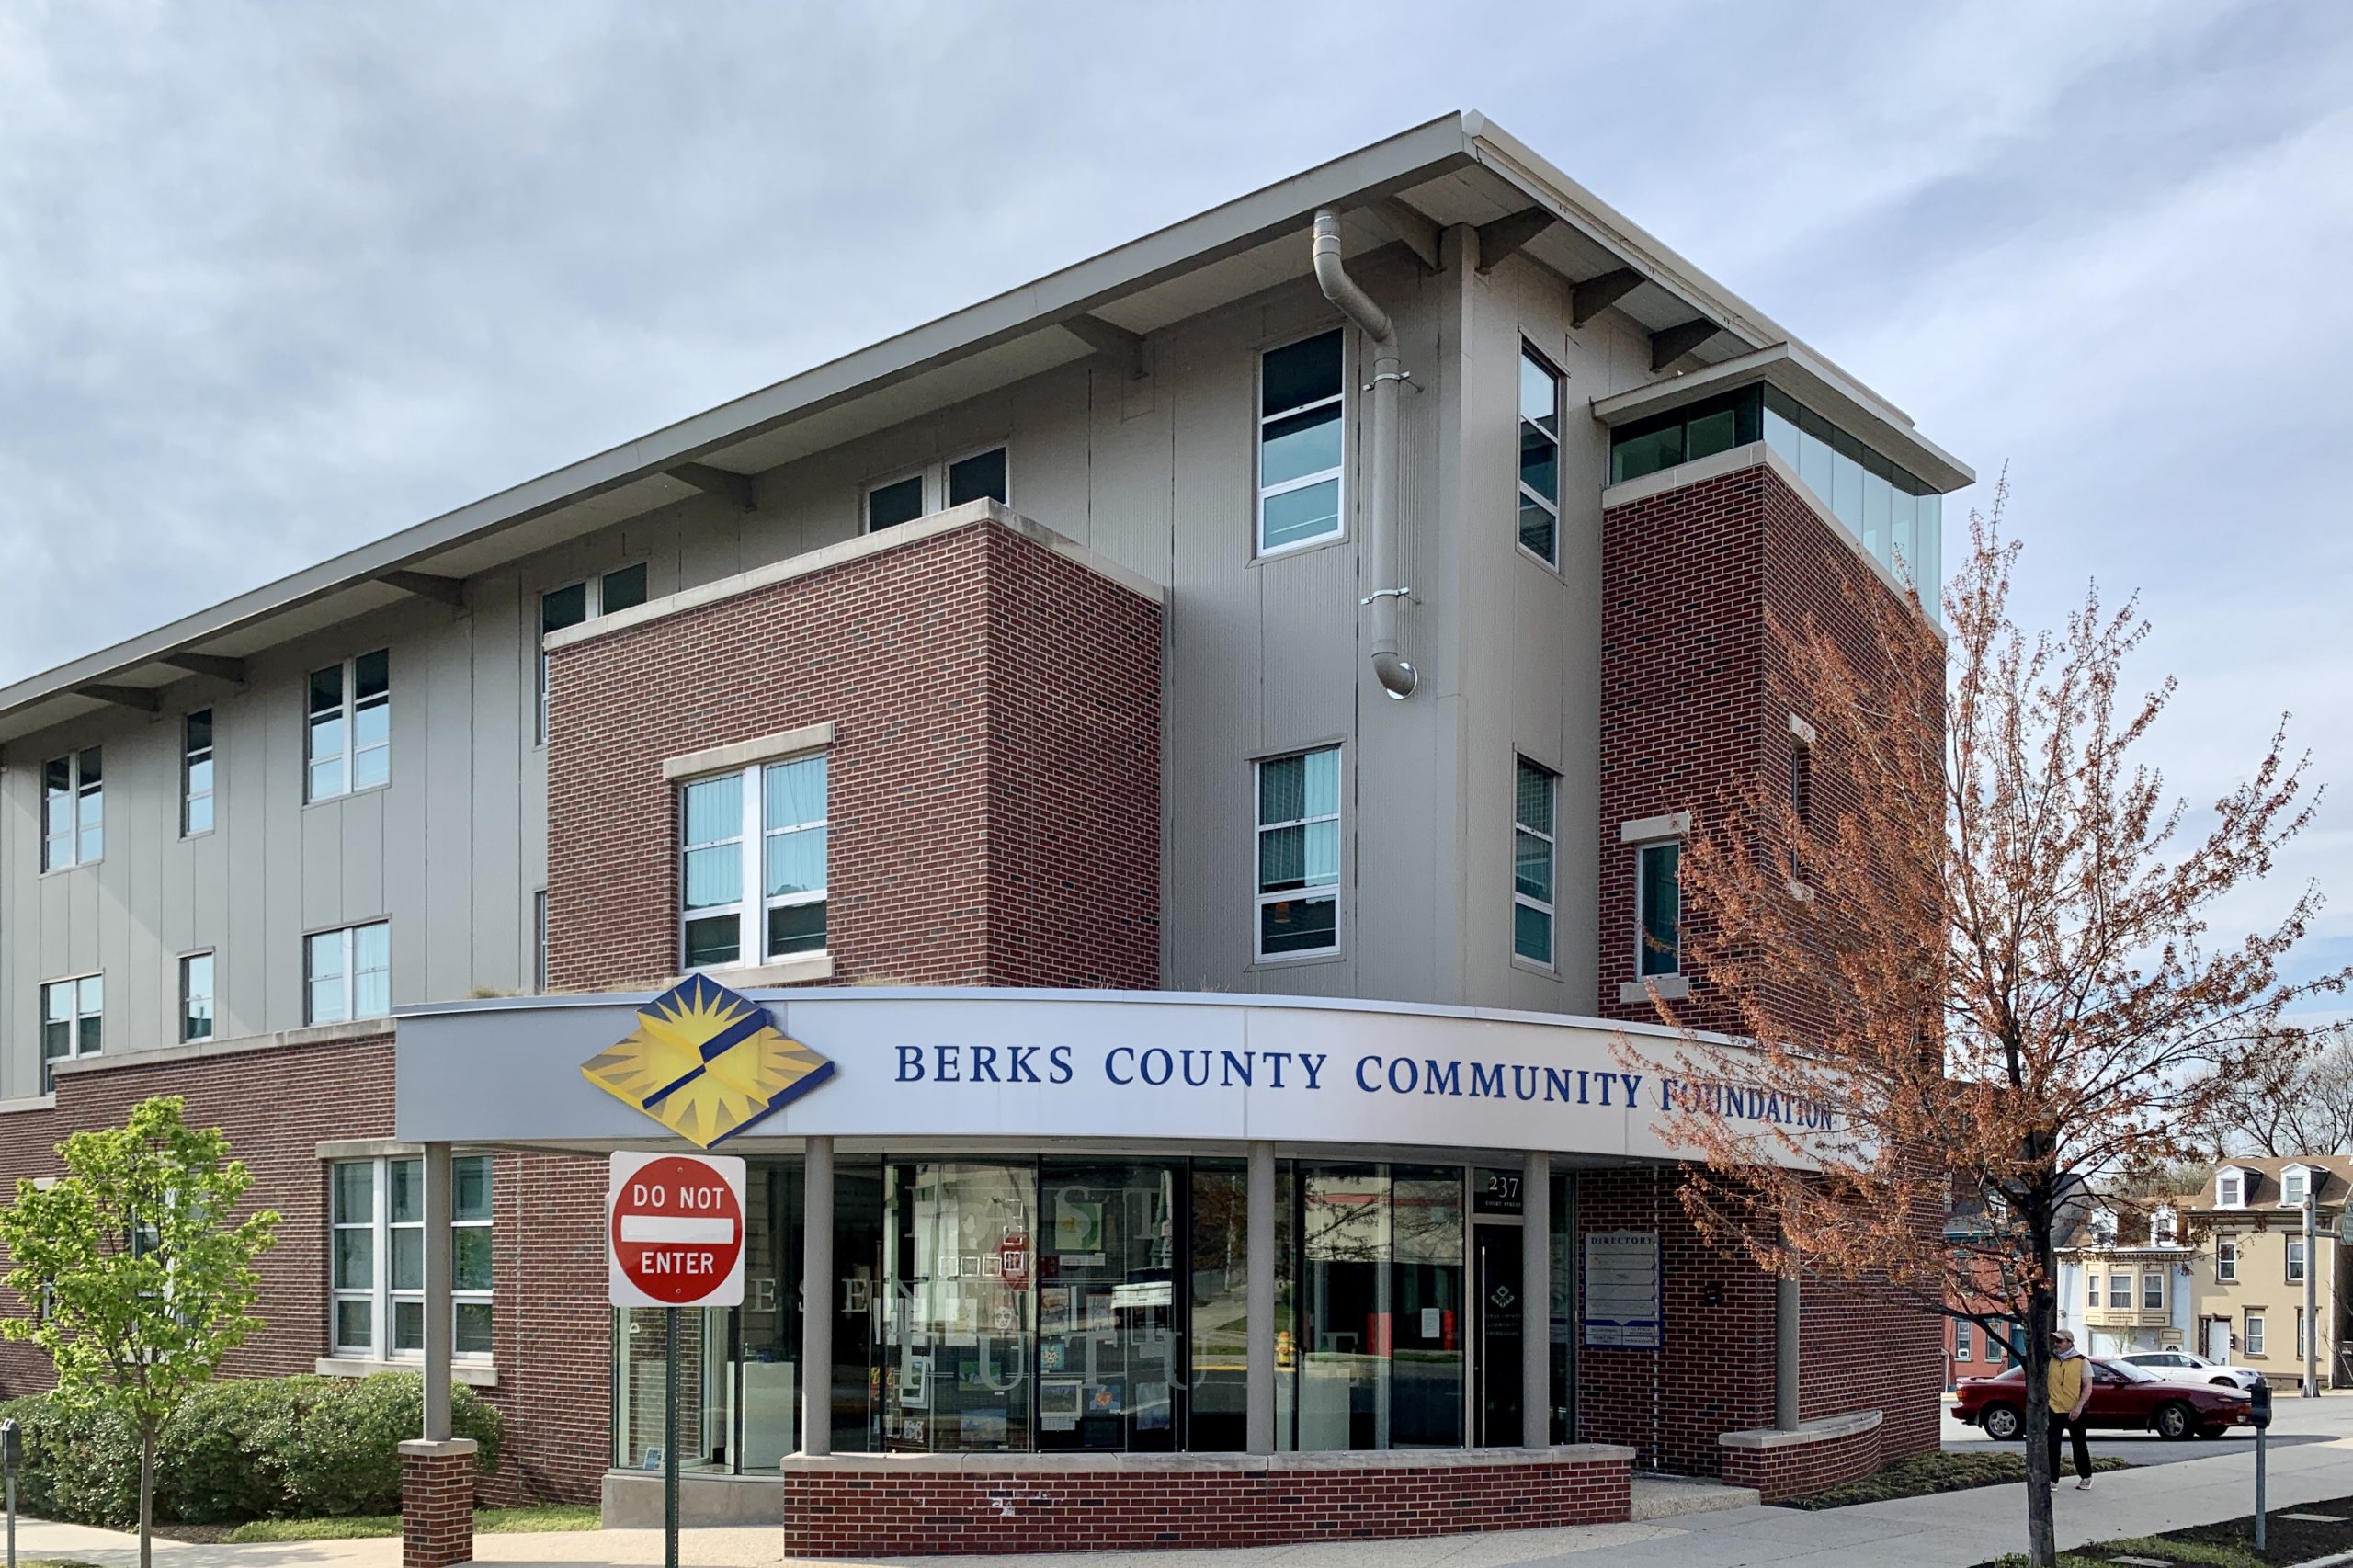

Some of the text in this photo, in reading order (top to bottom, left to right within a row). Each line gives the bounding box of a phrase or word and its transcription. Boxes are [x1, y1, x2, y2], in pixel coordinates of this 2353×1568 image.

[894, 1045, 1074, 1085] BERKS
[1104, 1047, 1328, 1090] COUNTY
[1355, 1055, 1643, 1108] COMMUNITY
[633, 1184, 724, 1210] DO NOT
[1488, 1176, 1518, 1199] 237
[1591, 1236, 1654, 1245] DIRECTORY
[642, 1251, 714, 1275] ENTER
